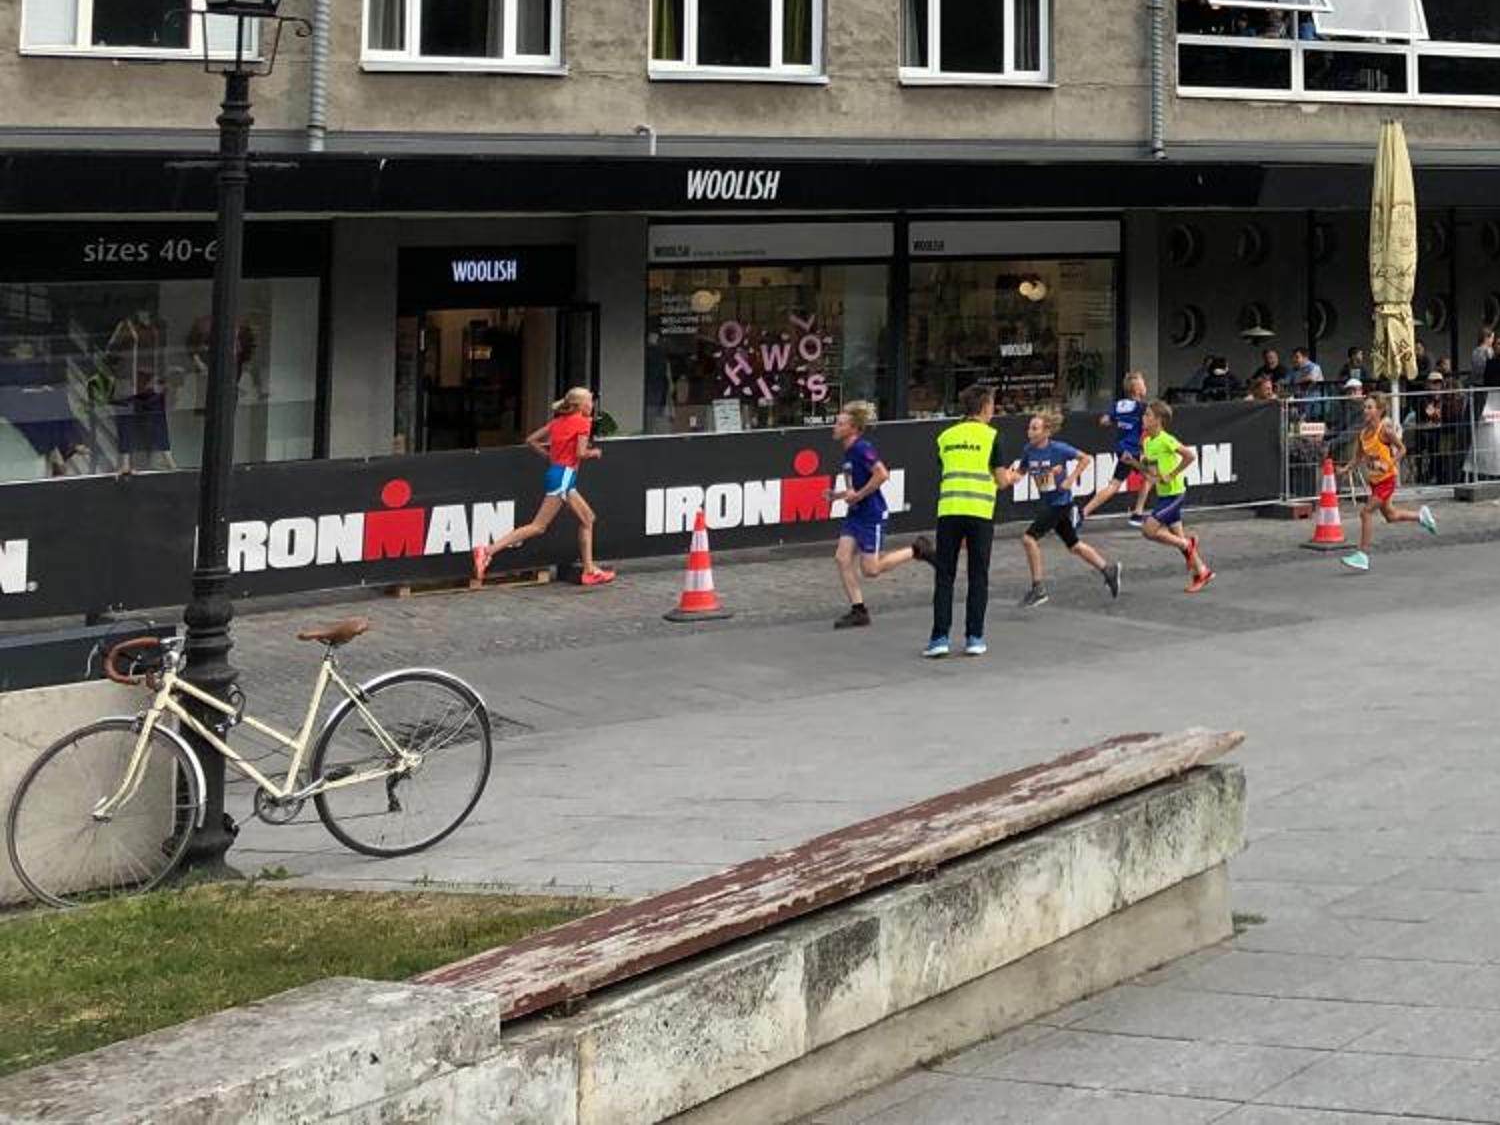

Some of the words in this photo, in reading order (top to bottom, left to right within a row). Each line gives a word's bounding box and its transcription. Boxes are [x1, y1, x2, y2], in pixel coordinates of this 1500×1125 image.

[686, 169, 781, 200] WOOLISH
[83, 237, 149, 262] sizes
[451, 259, 517, 282] WOOLISH
[1013, 442, 1232, 502] IONN
[227, 479, 516, 573] RONMAN
